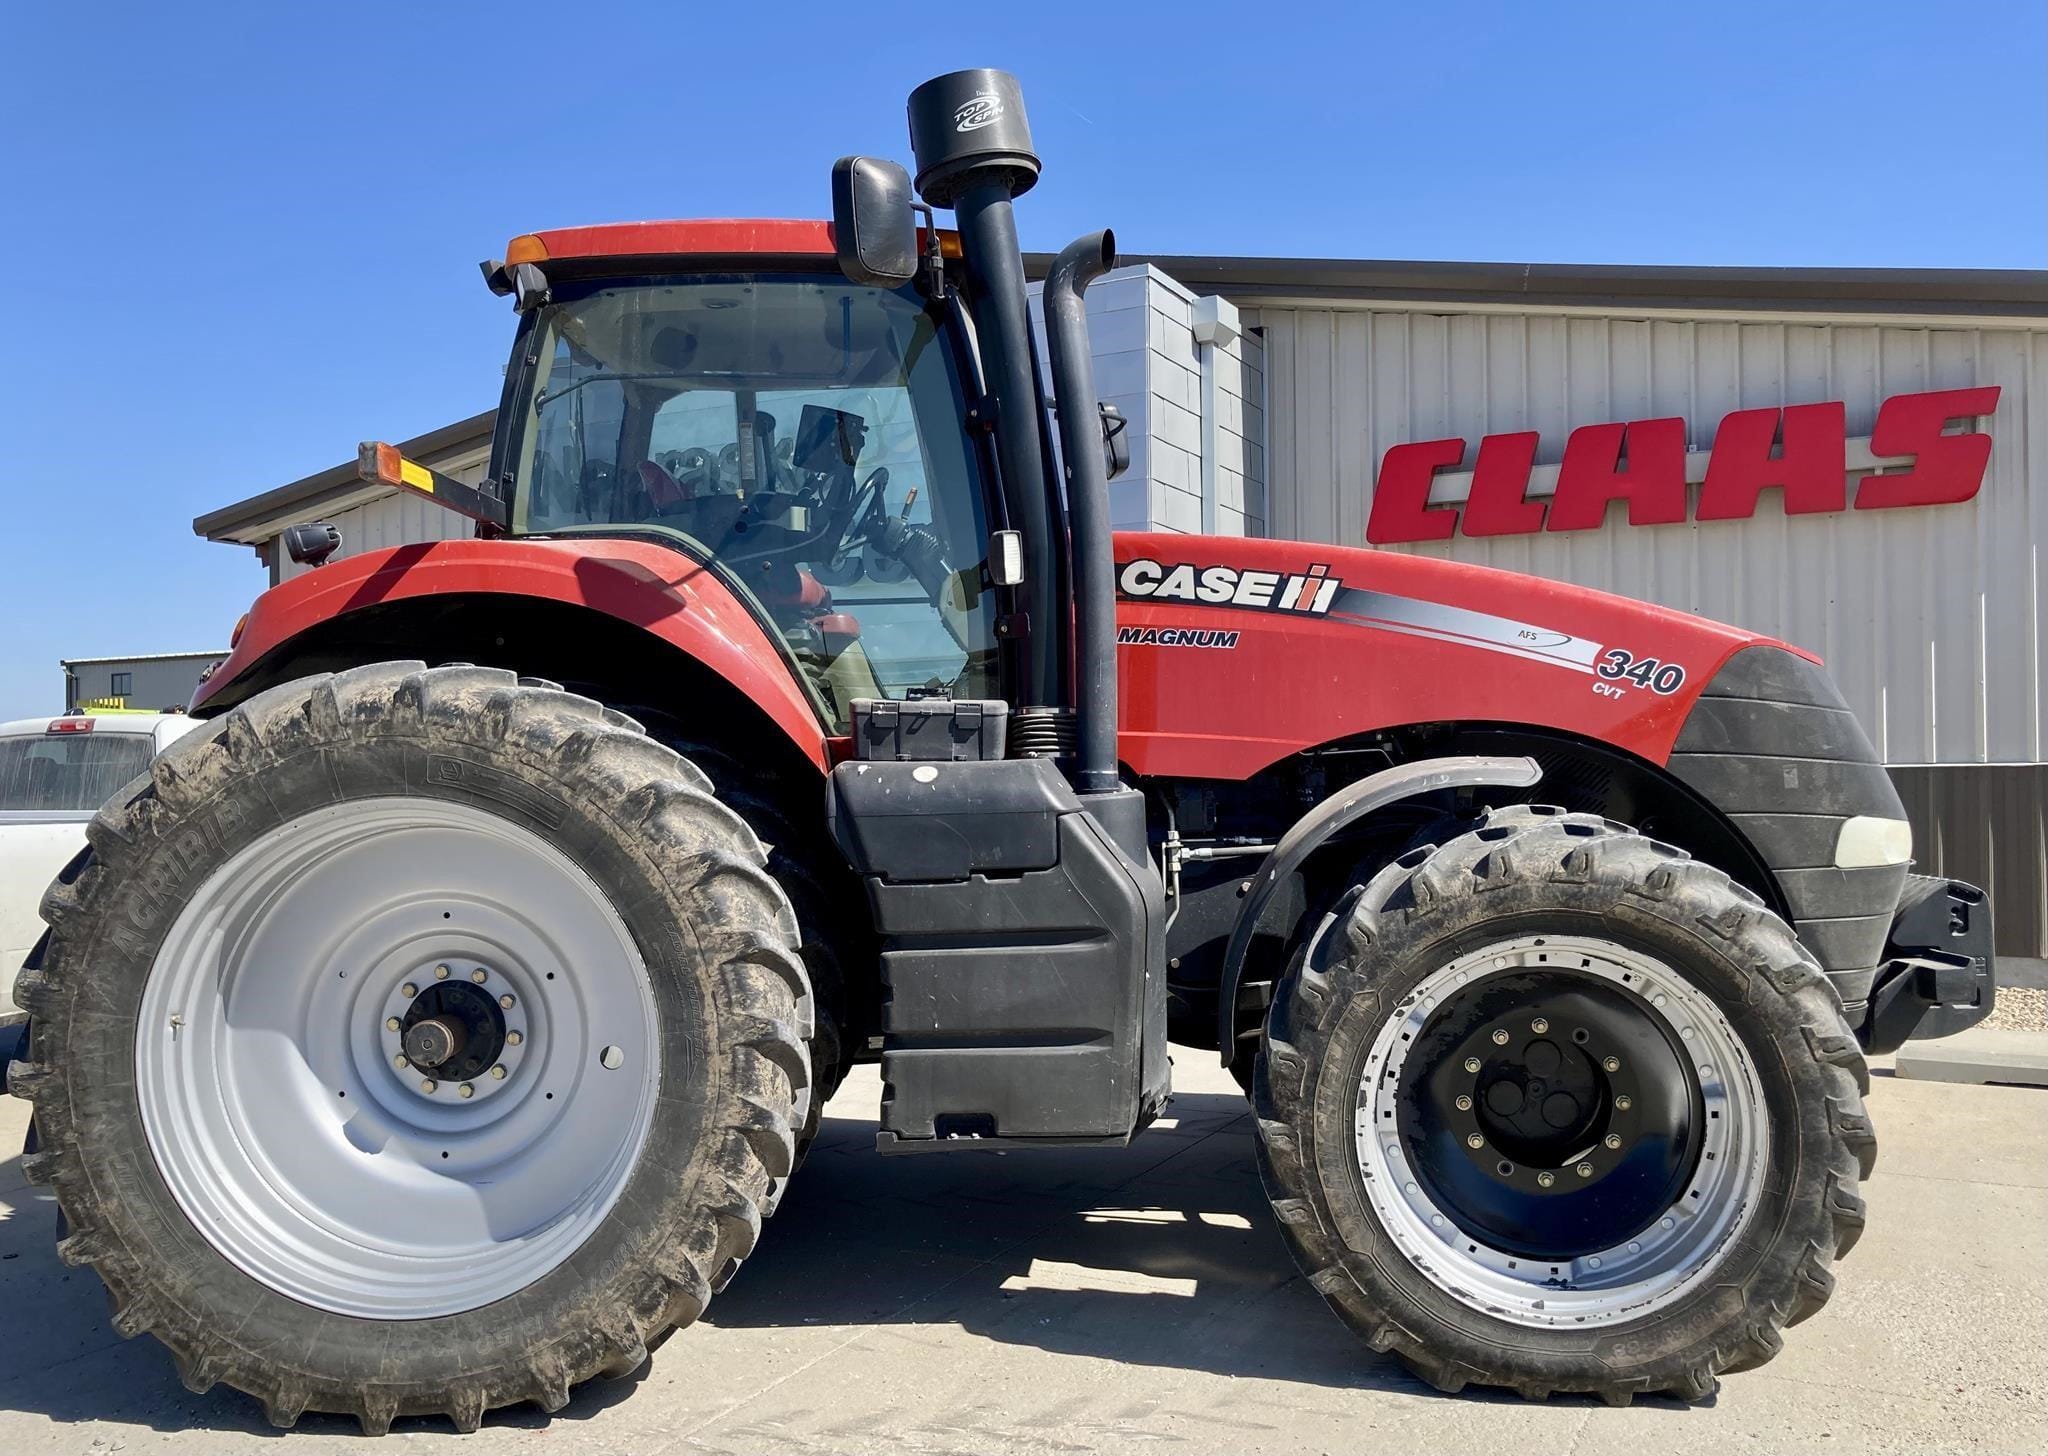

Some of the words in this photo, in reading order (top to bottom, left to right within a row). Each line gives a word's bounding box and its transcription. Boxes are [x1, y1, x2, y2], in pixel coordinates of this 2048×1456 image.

[954, 102, 985, 122] TOP
[974, 105, 1004, 124] SPIN
[1366, 386, 2001, 544] CLAAS
[1120, 560, 1280, 607] CASE
[1117, 627, 1240, 649] MAGNUM
[1518, 630, 1537, 641] AFS
[1597, 649, 1686, 695] 340
[1592, 682, 1626, 700] CVT
